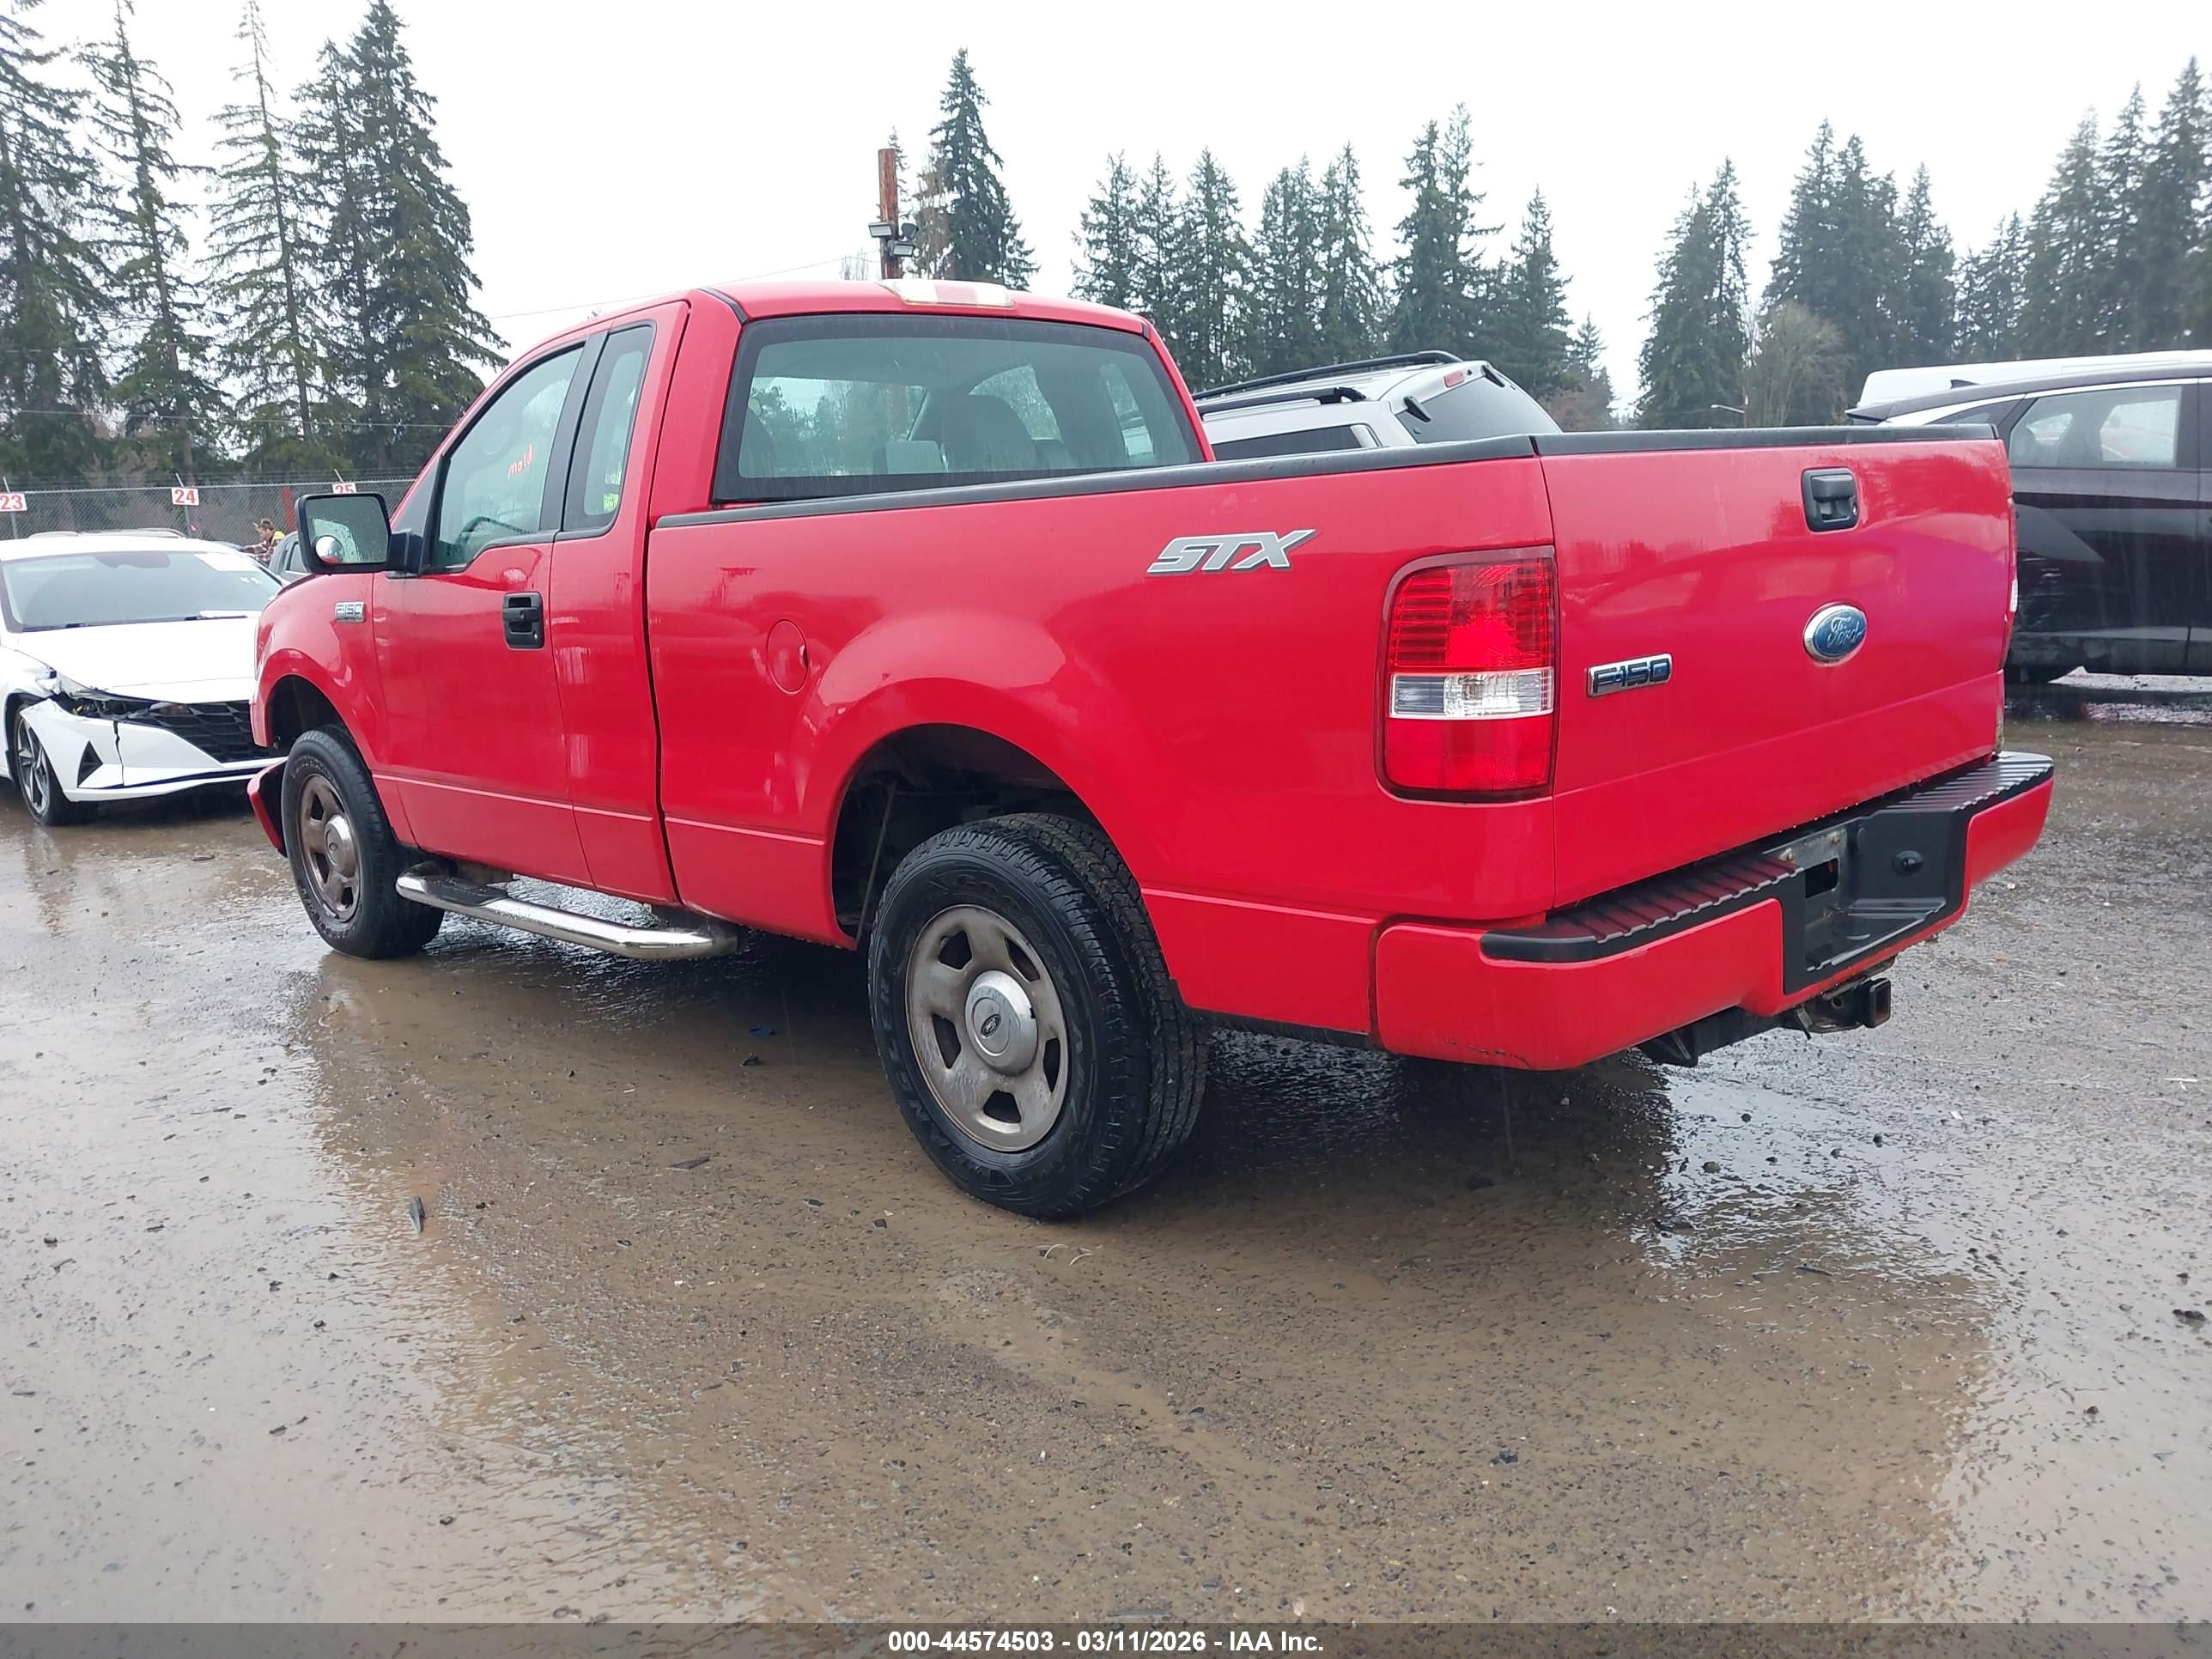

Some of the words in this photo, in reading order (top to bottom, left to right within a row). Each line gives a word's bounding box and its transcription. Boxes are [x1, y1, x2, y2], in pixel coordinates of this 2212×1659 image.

[0, 495, 23, 510] 23
[174, 489, 195, 504] 24
[1146, 528, 1316, 574] STX
[1827, 616, 1866, 649] Ford
